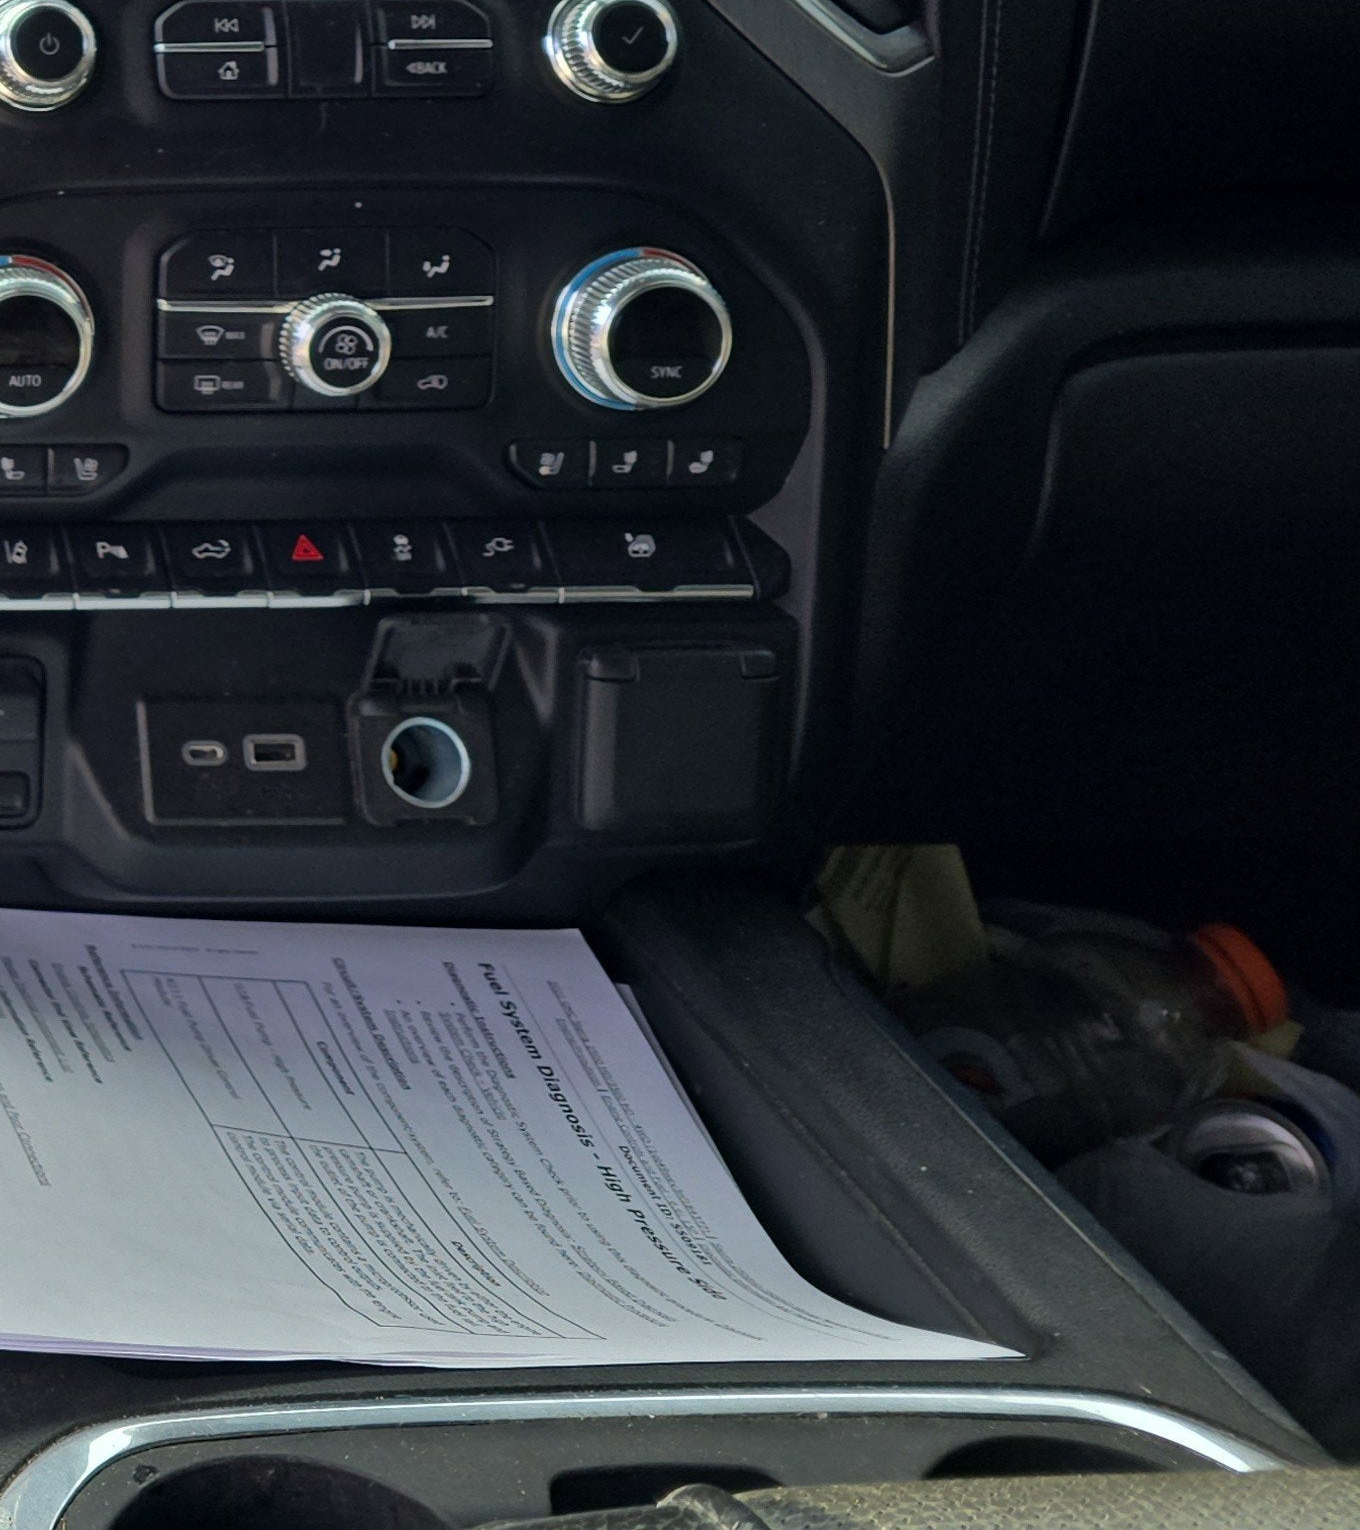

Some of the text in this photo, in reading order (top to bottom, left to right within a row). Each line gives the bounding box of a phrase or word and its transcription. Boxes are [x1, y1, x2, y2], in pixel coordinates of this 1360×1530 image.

[426, 326, 449, 339] A/C
[324, 357, 369, 370] ON/OFF
[650, 366, 682, 378] SYNC
[9, 374, 42, 388] AUTO
[475, 963, 511, 995] Fuel
[495, 1000, 547, 1059] System
[533, 1065, 597, 1147] Diagnosis
[594, 1165, 636, 1202] High
[623, 1208, 693, 1274] Pressure
[685, 1277, 729, 1300] Side
[616, 1146, 663, 1199] Document
